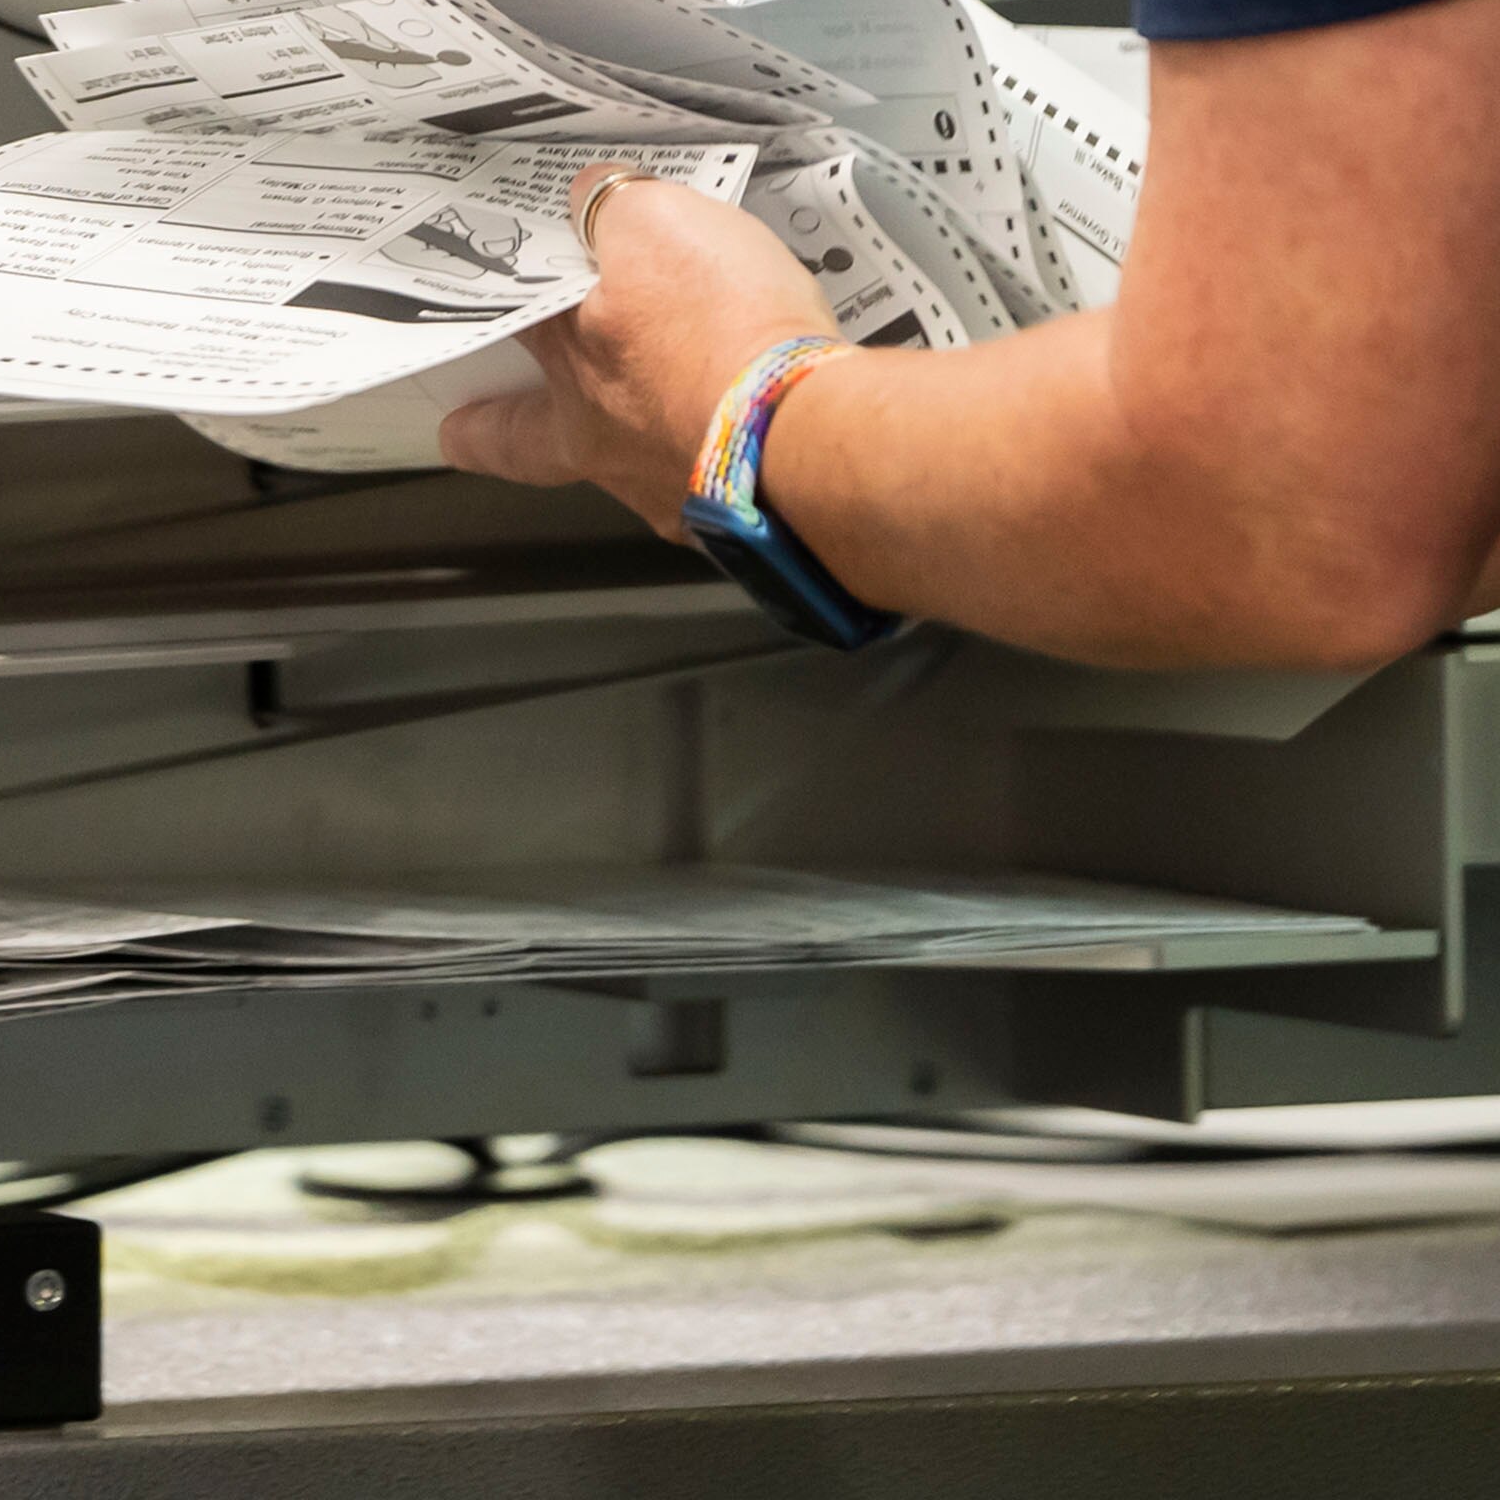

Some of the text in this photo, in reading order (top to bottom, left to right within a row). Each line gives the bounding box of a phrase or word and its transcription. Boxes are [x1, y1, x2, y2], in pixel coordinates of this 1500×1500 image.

[618, 148, 647, 162] You
[682, 150, 707, 163] the
[1088, 157, 1126, 194] Baker,
[260, 192, 310, 203] Brown
[326, 211, 351, 222] for
[352, 213, 386, 226] Vote
[247, 221, 308, 232] General
[1056, 199, 1113, 249] Governor
